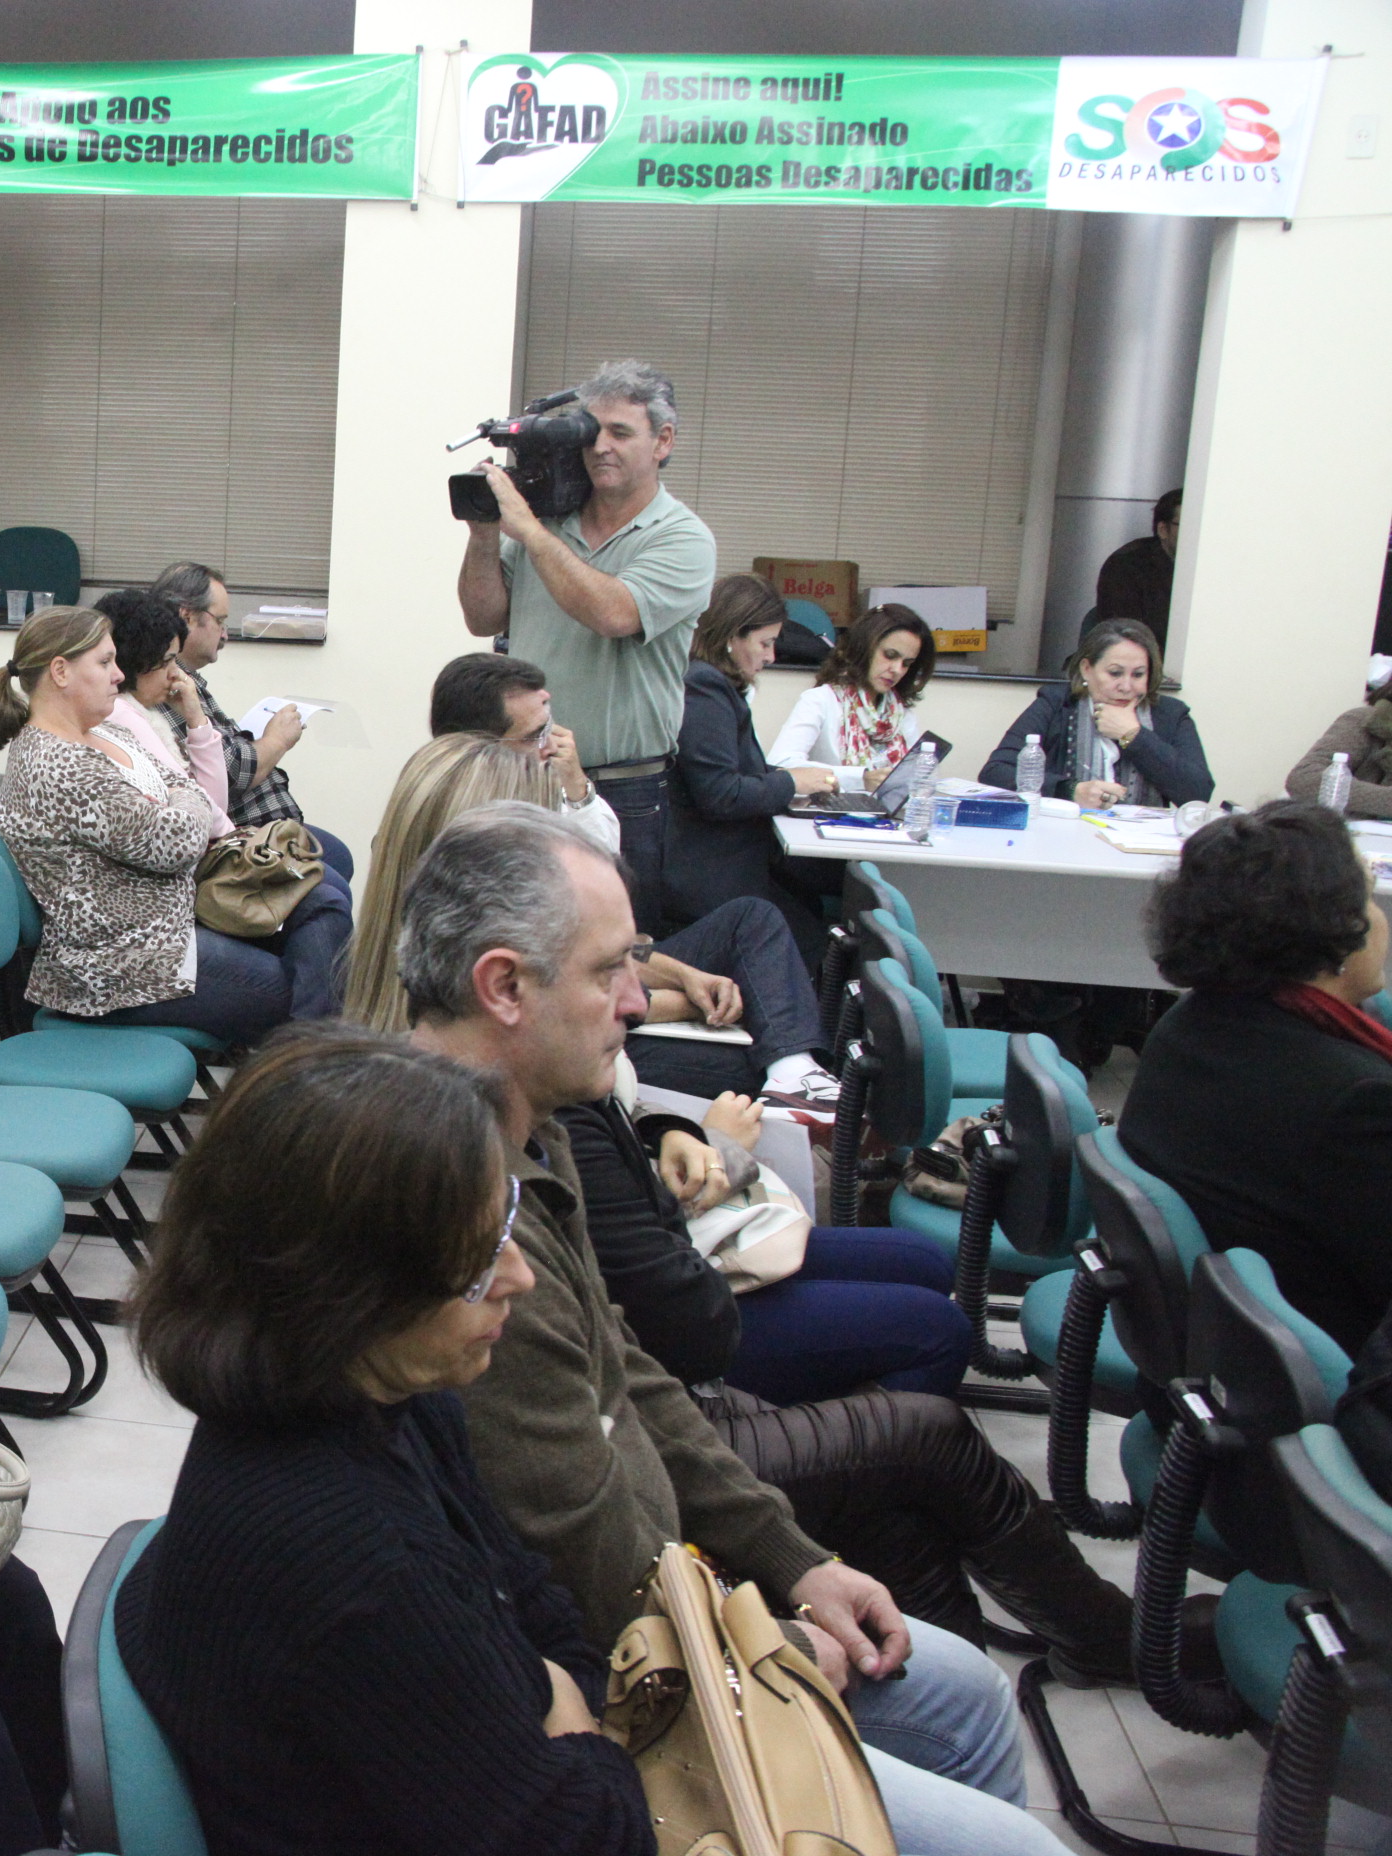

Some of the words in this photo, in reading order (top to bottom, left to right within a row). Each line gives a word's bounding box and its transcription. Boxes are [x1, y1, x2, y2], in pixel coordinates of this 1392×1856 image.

[641, 72, 752, 101] Assine
[759, 73, 845, 104] aqui!
[107, 96, 171, 124] aos
[484, 104, 607, 144] GAFAD
[638, 115, 748, 145] Abaixo
[754, 116, 909, 146] Assinado
[1064, 87, 1281, 172] SOS
[24, 129, 68, 162] de
[77, 128, 354, 167] Desaparecidos
[637, 158, 772, 189] Pessoas
[780, 160, 1033, 193] Desaparecidas
[1058, 162, 1282, 183] DESAPARECIDOS
[783, 578, 836, 598] Belga
